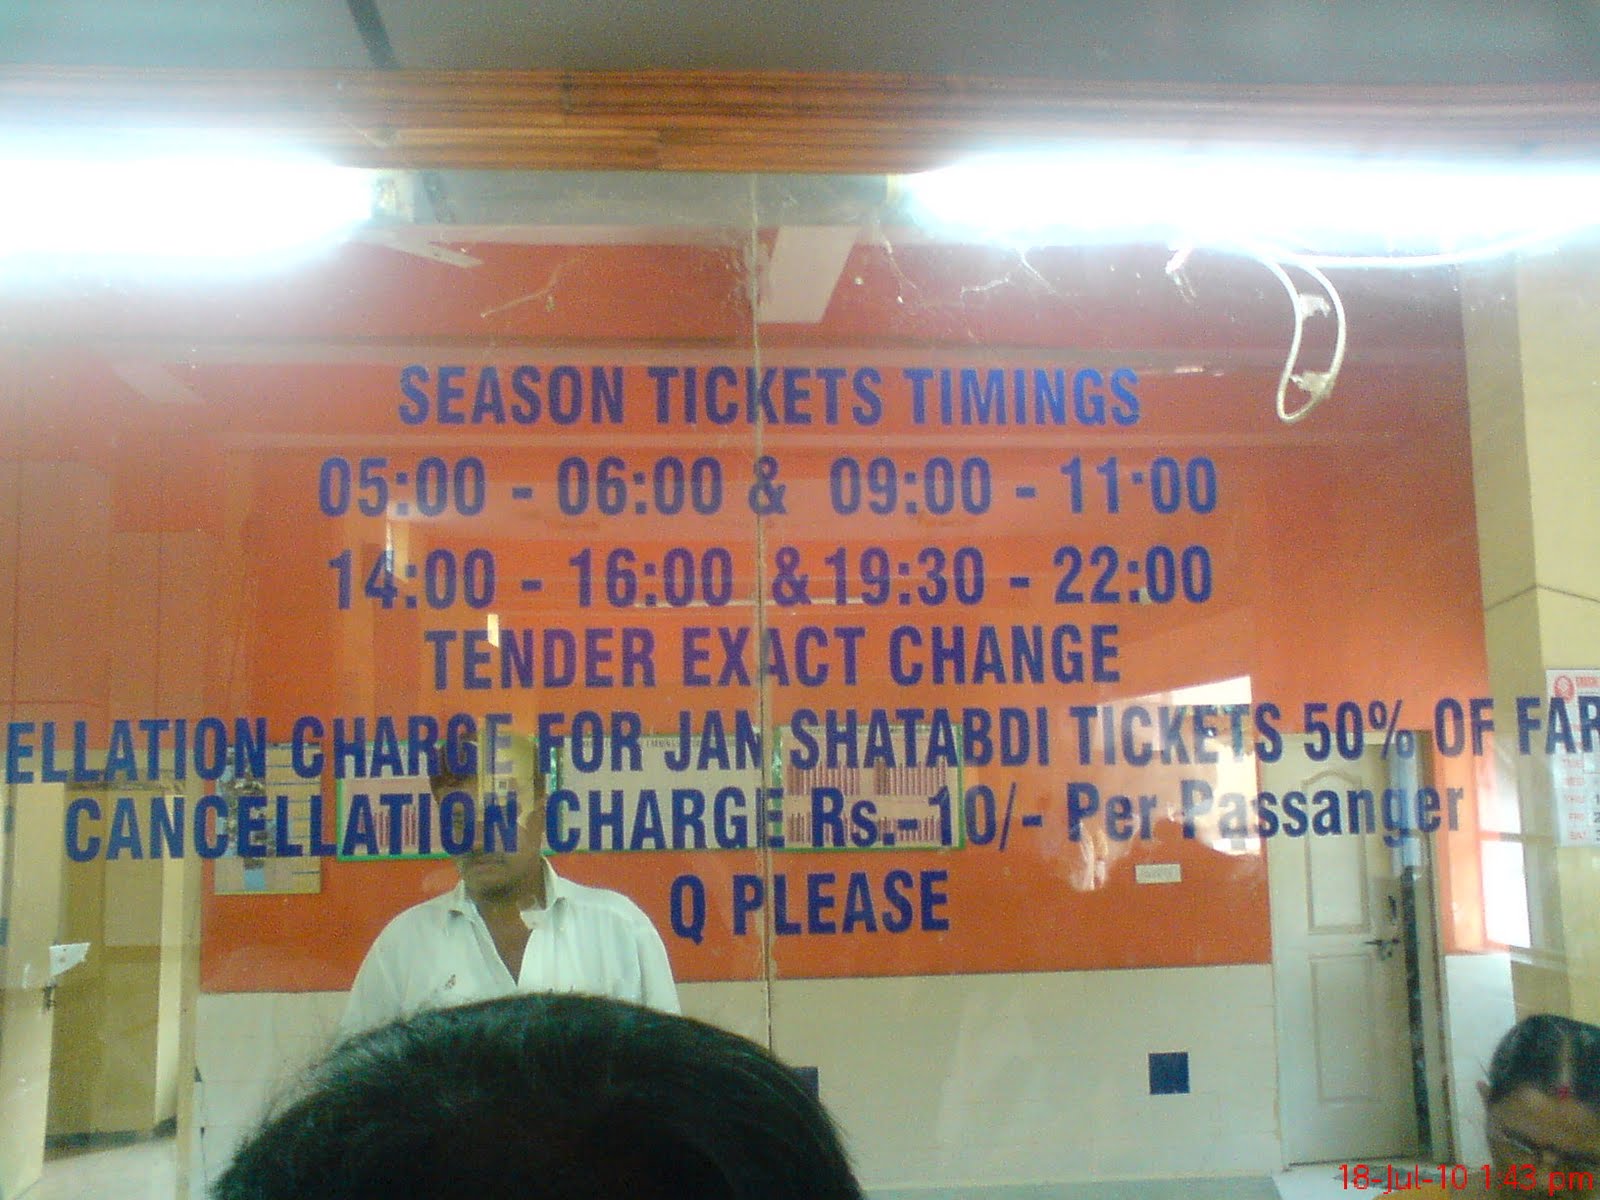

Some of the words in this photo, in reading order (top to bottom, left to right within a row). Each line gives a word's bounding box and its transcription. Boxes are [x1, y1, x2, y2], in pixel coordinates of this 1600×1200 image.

[399, 364, 624, 425] SEASON
[648, 365, 883, 426] TICKETS
[904, 367, 1140, 426] TIMINGS
[319, 456, 486, 517] 05:00
[512, 485, 533, 499] -
[557, 455, 723, 516] 06:00
[748, 455, 788, 515] &
[830, 455, 992, 516] 09:00
[1015, 485, 1037, 499] -
[328, 548, 496, 610] 14:00
[520, 577, 543, 592] -
[570, 547, 734, 609] 16:00
[1009, 576, 1030, 589] -
[1053, 544, 1213, 604] 22:00
[425, 627, 656, 691] TENDER
[683, 625, 866, 688] EXACT
[889, 623, 1121, 687] CHANGE
[5, 715, 267, 785] ELLATION
[291, 712, 514, 780] CHARGE
[537, 710, 643, 774] FOR
[664, 708, 765, 771] JAN
[790, 704, 1049, 770] SHATABDI
[1069, 703, 1284, 767] TICKETS
[1303, 700, 1416, 763] 50%
[1434, 698, 1496, 758] OF
[1516, 695, 1600, 755] FAR
[65, 790, 518, 863] CANCELLATION
[545, 786, 784, 854] CHARGE
[1066, 783, 1157, 843] Per
[1179, 777, 1465, 848] Passanger
[670, 874, 707, 945] Q
[733, 870, 949, 936] PLEASE
